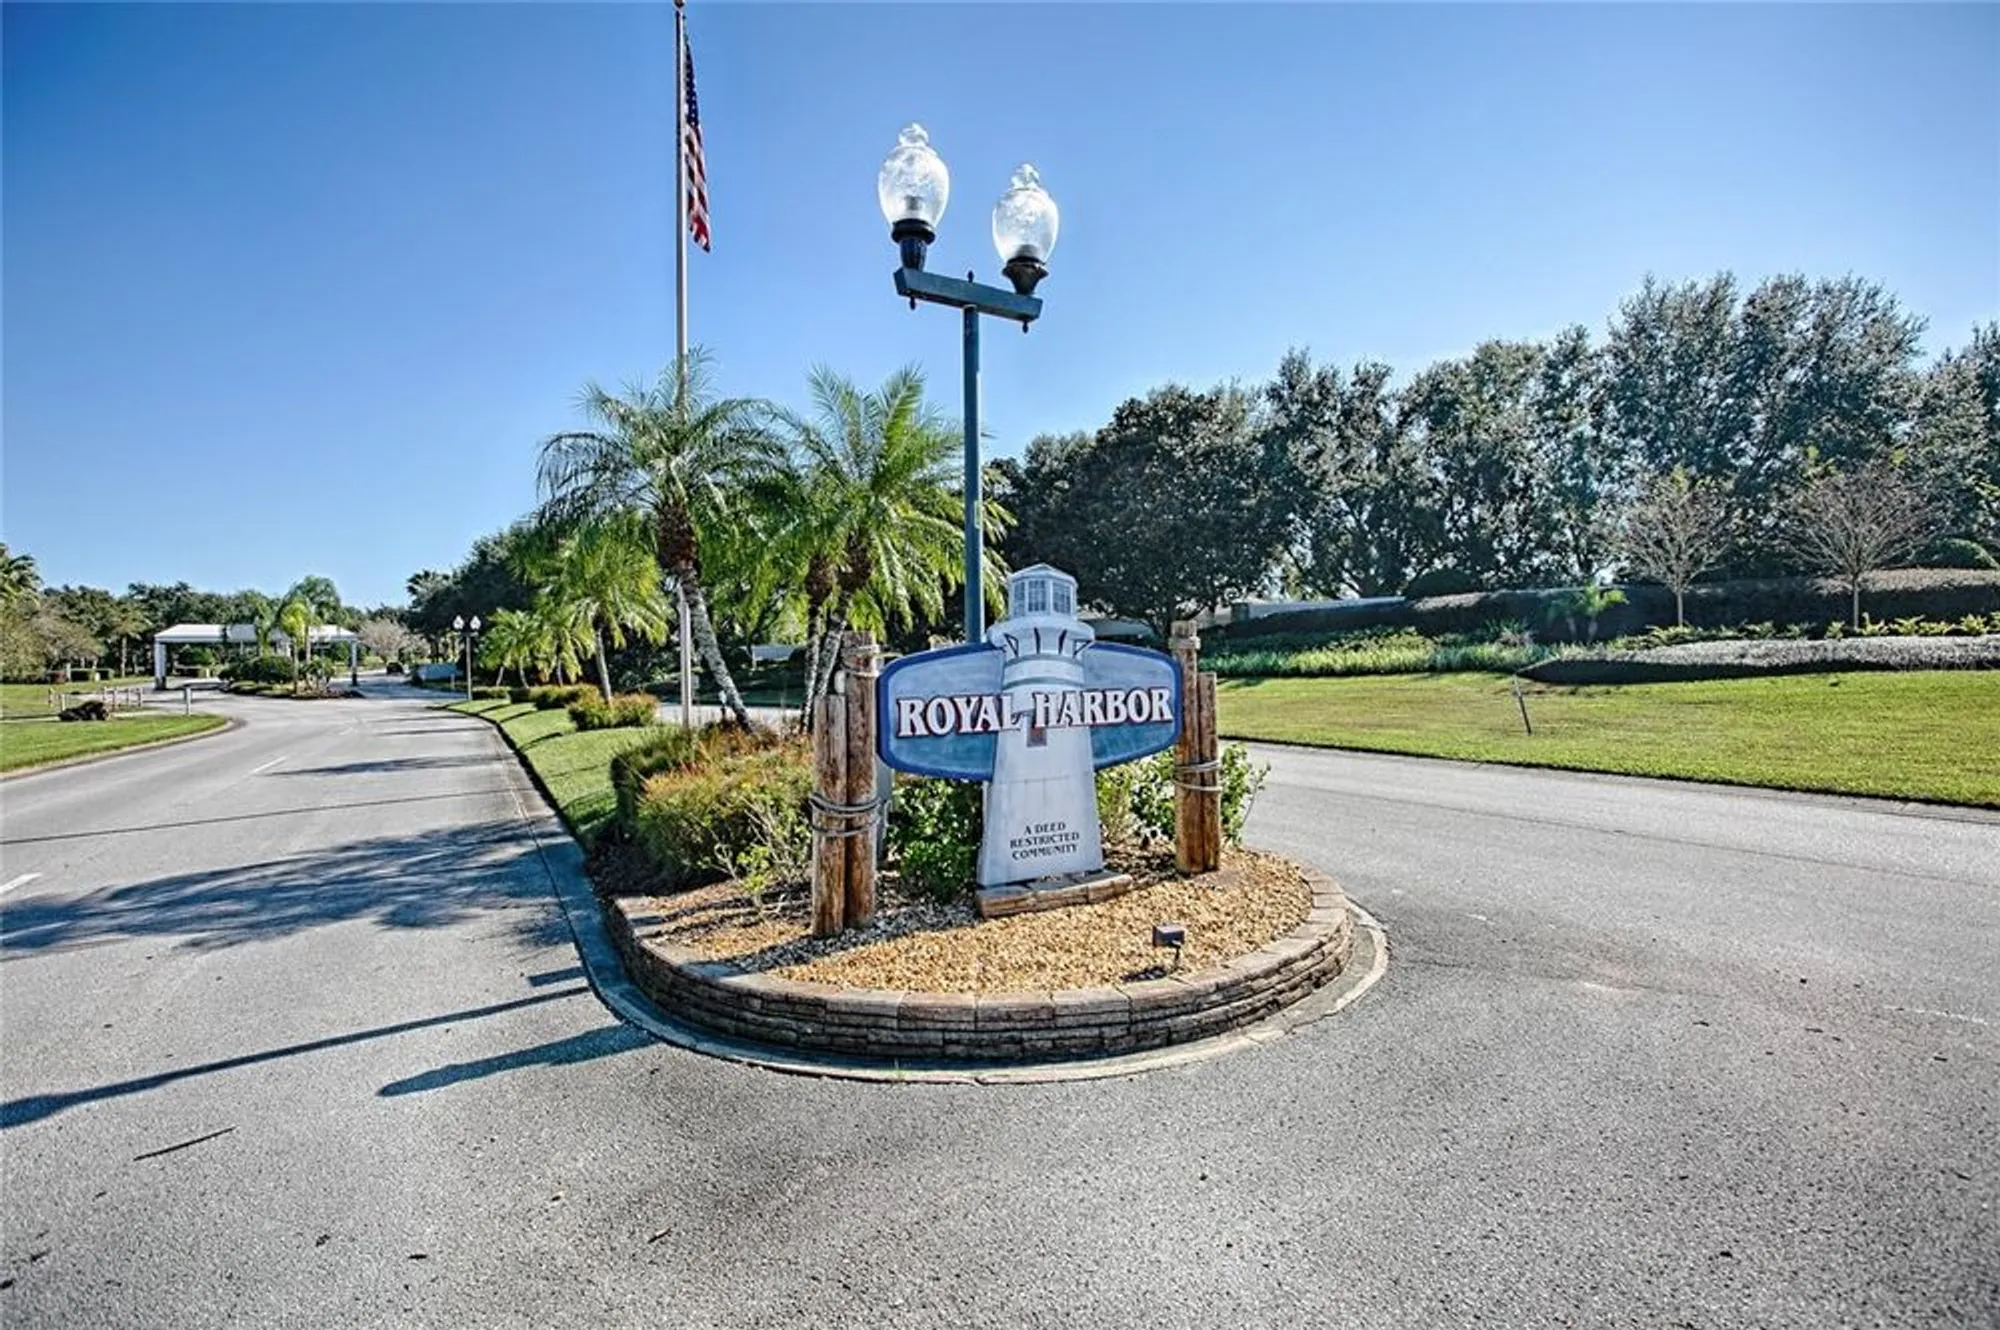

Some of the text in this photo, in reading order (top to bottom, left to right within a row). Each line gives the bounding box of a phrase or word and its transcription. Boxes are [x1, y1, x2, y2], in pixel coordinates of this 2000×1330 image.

[897, 687, 1174, 738] ROYAL HARBOR
[1024, 821, 1067, 836] A DEED
[1009, 831, 1080, 849] RESTRICTED
[1011, 843, 1077, 861] COMMUNITY
